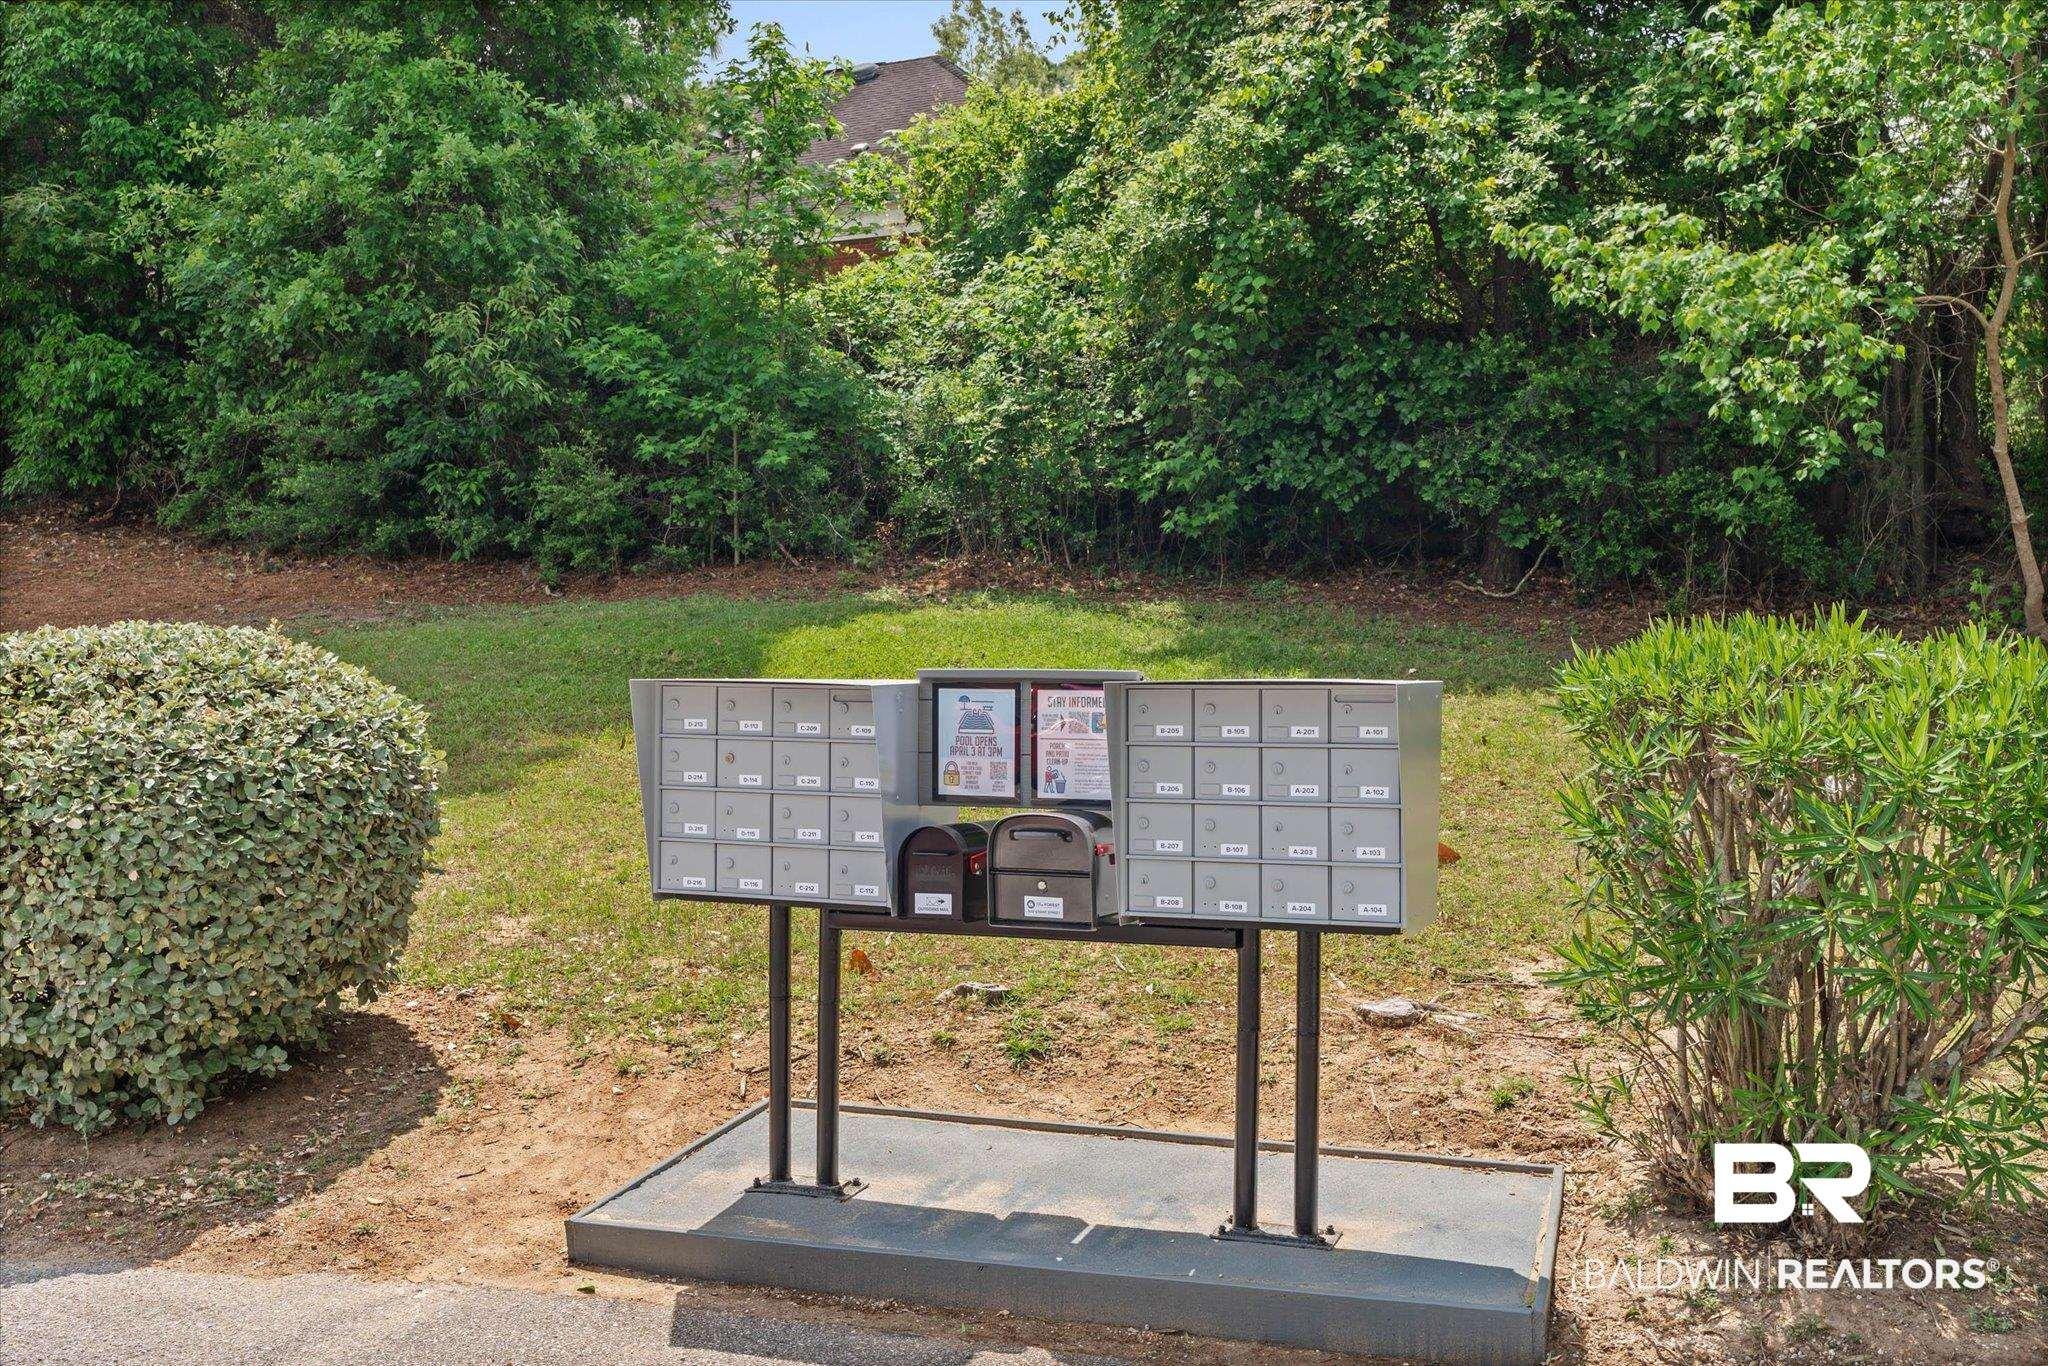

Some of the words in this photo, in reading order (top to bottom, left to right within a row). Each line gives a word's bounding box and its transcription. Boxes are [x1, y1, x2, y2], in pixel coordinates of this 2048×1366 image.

[1048, 696, 1066, 708] STAY
[1068, 696, 1104, 708] INFORME
[955, 736, 973, 746] POOL
[975, 736, 997, 746] OPENS
[950, 746, 970, 756] APRIL
[978, 746, 985, 756] AT
[988, 747, 1002, 757] 3PM
